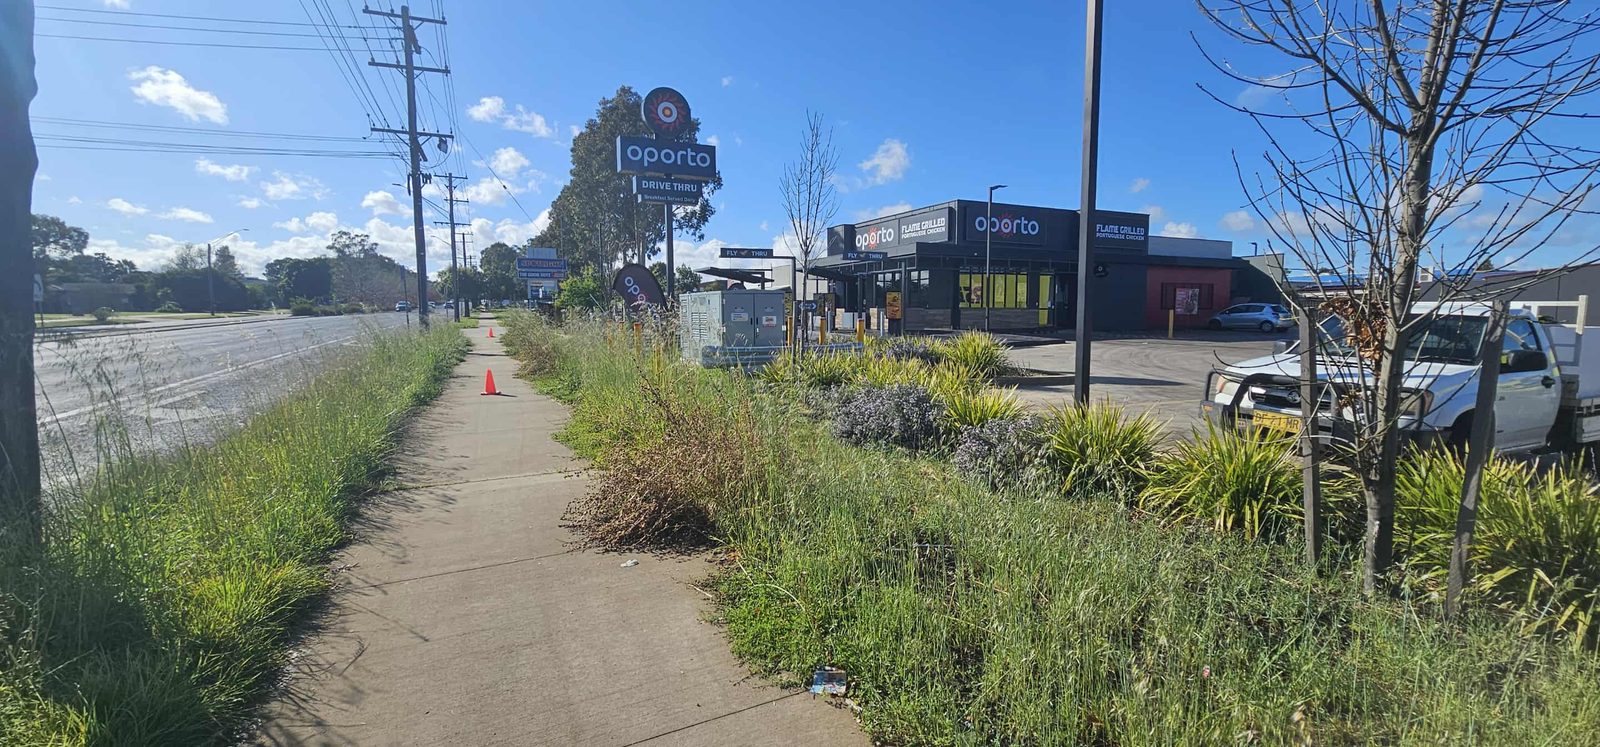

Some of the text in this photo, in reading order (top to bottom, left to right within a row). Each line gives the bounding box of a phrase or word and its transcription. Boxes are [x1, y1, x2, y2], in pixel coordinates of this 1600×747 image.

[626, 145, 711, 168] oporto
[642, 180, 697, 192] DRIVE THRU
[901, 217, 946, 234] FLAME GRILLED
[1096, 224, 1145, 236] FLAME GRILLED
[856, 226, 894, 250] oporto
